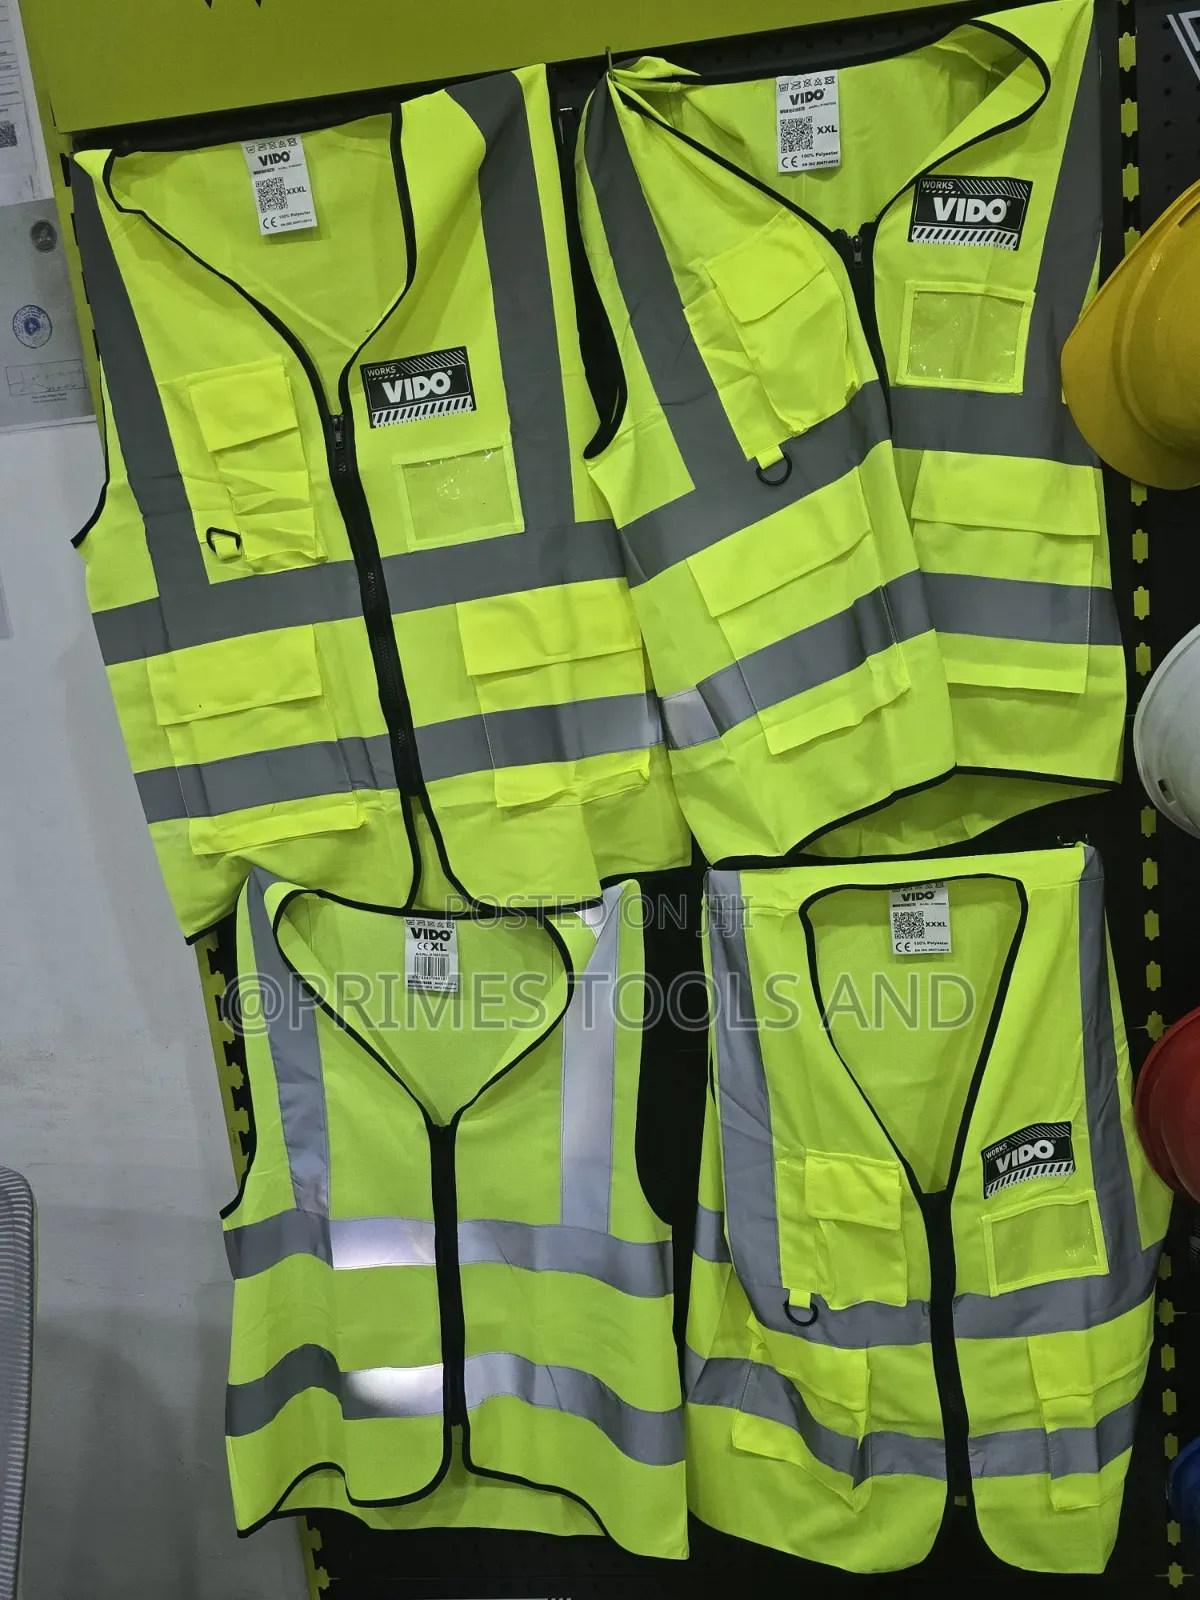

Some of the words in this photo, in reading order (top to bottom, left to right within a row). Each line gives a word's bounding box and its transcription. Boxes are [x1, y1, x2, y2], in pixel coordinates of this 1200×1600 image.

[789, 89, 824, 106] VIDO
[816, 125, 837, 135] XXL
[258, 151, 290, 167] VIDO
[286, 186, 307, 196] XXXL
[922, 180, 954, 190] WORKS
[933, 197, 1007, 223] VIDO
[366, 366, 396, 377] WORKS
[382, 371, 451, 403] VIDO
[901, 891, 935, 902] VIDO
[410, 927, 451, 941] VIDO
[430, 942, 447, 951] XL
[985, 1142, 1008, 1159] WORKS
[995, 1139, 1054, 1174] VIDO
